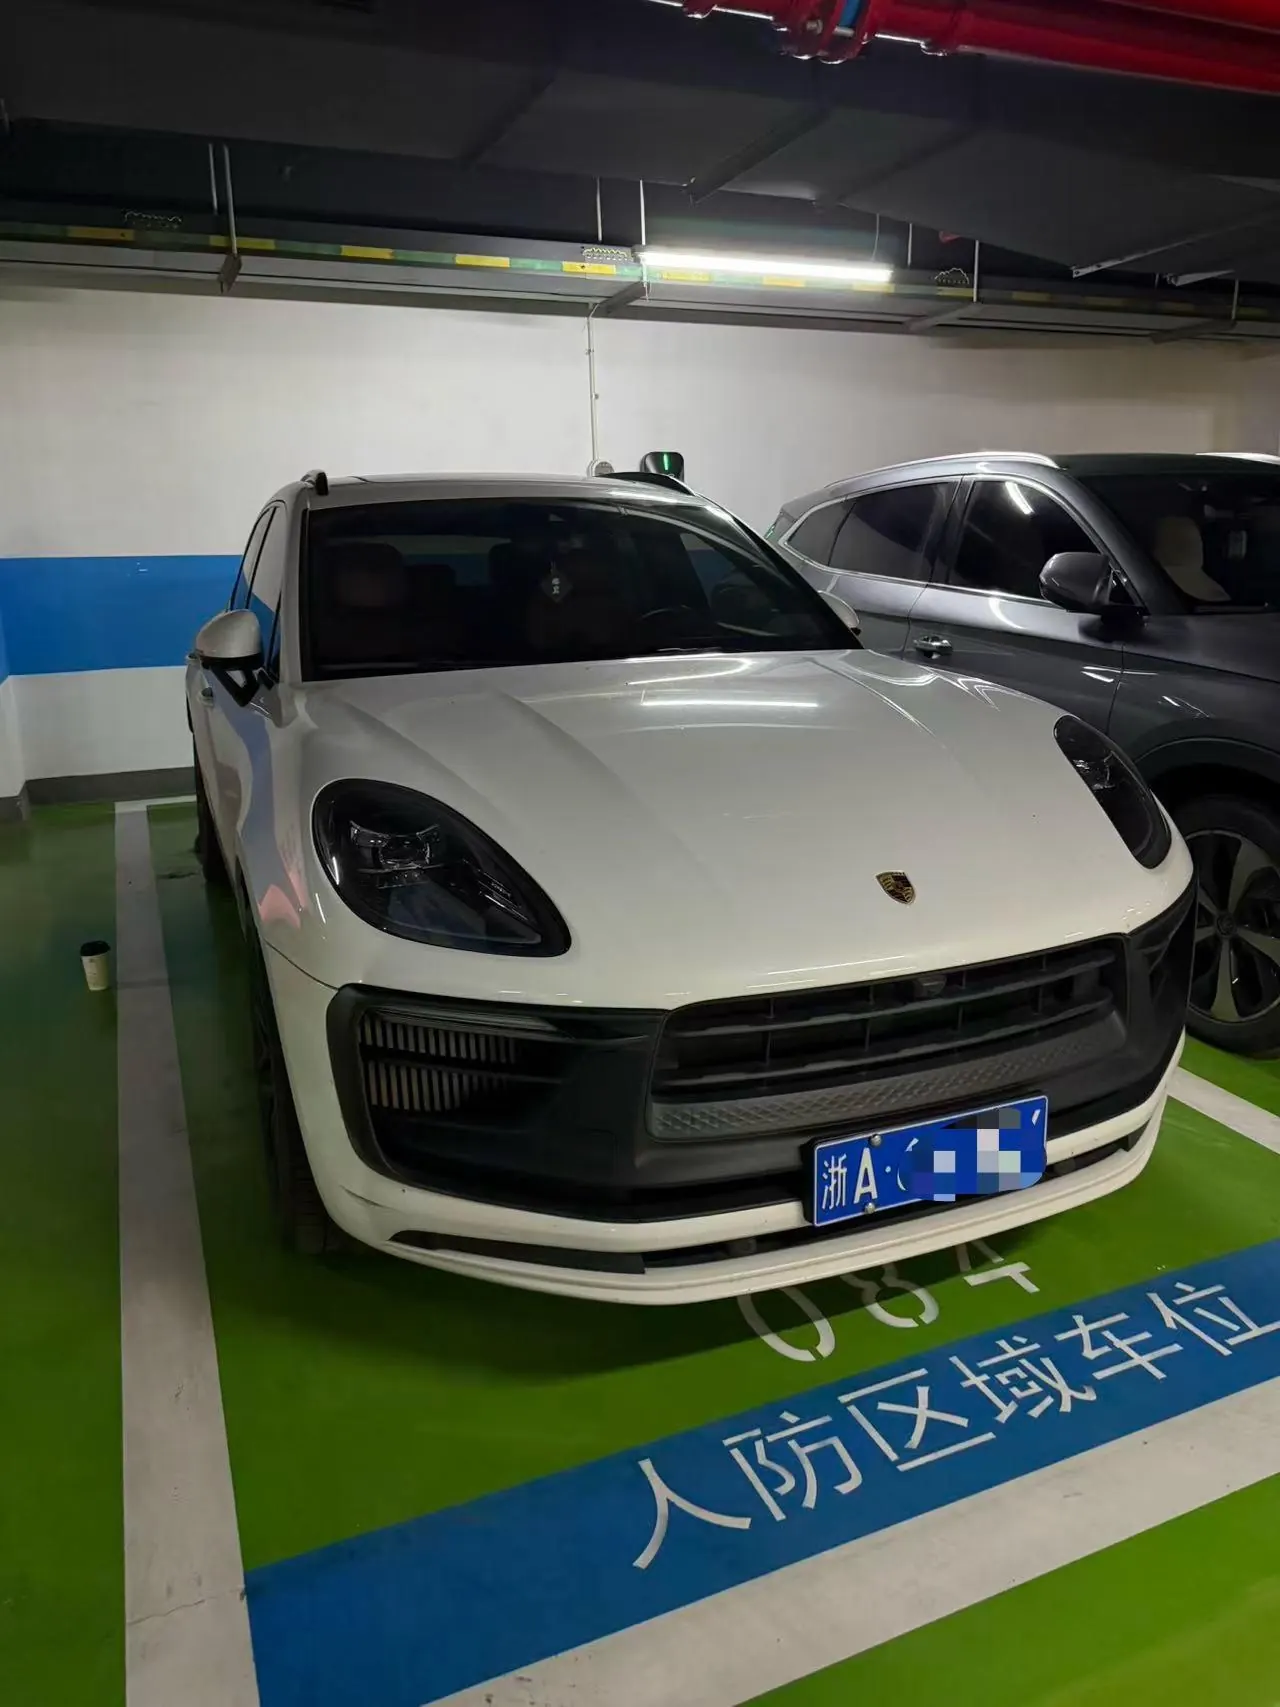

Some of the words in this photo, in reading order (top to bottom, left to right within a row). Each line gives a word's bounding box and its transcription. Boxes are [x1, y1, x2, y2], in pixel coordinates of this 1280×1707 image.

[632, 1281, 1280, 1570] 人防区域车位
